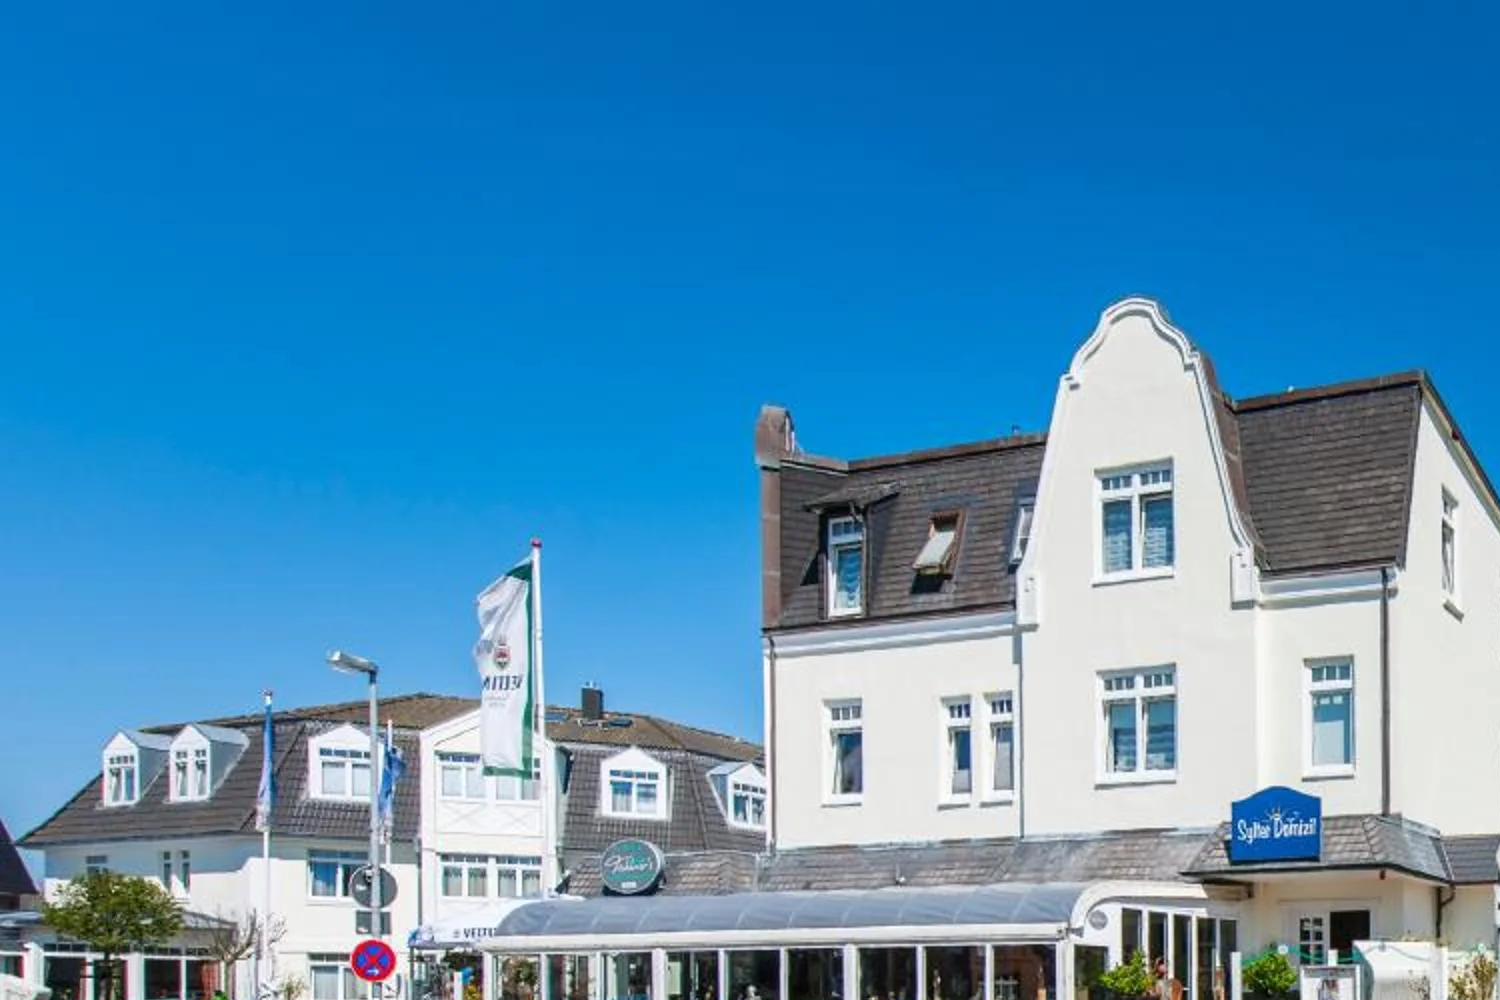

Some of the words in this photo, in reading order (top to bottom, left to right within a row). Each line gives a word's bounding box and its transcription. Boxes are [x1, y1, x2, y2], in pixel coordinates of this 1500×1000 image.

[1237, 818, 1271, 845] Sylter
[1273, 816, 1318, 839] Domizil
[463, 927, 497, 938] VELTI
